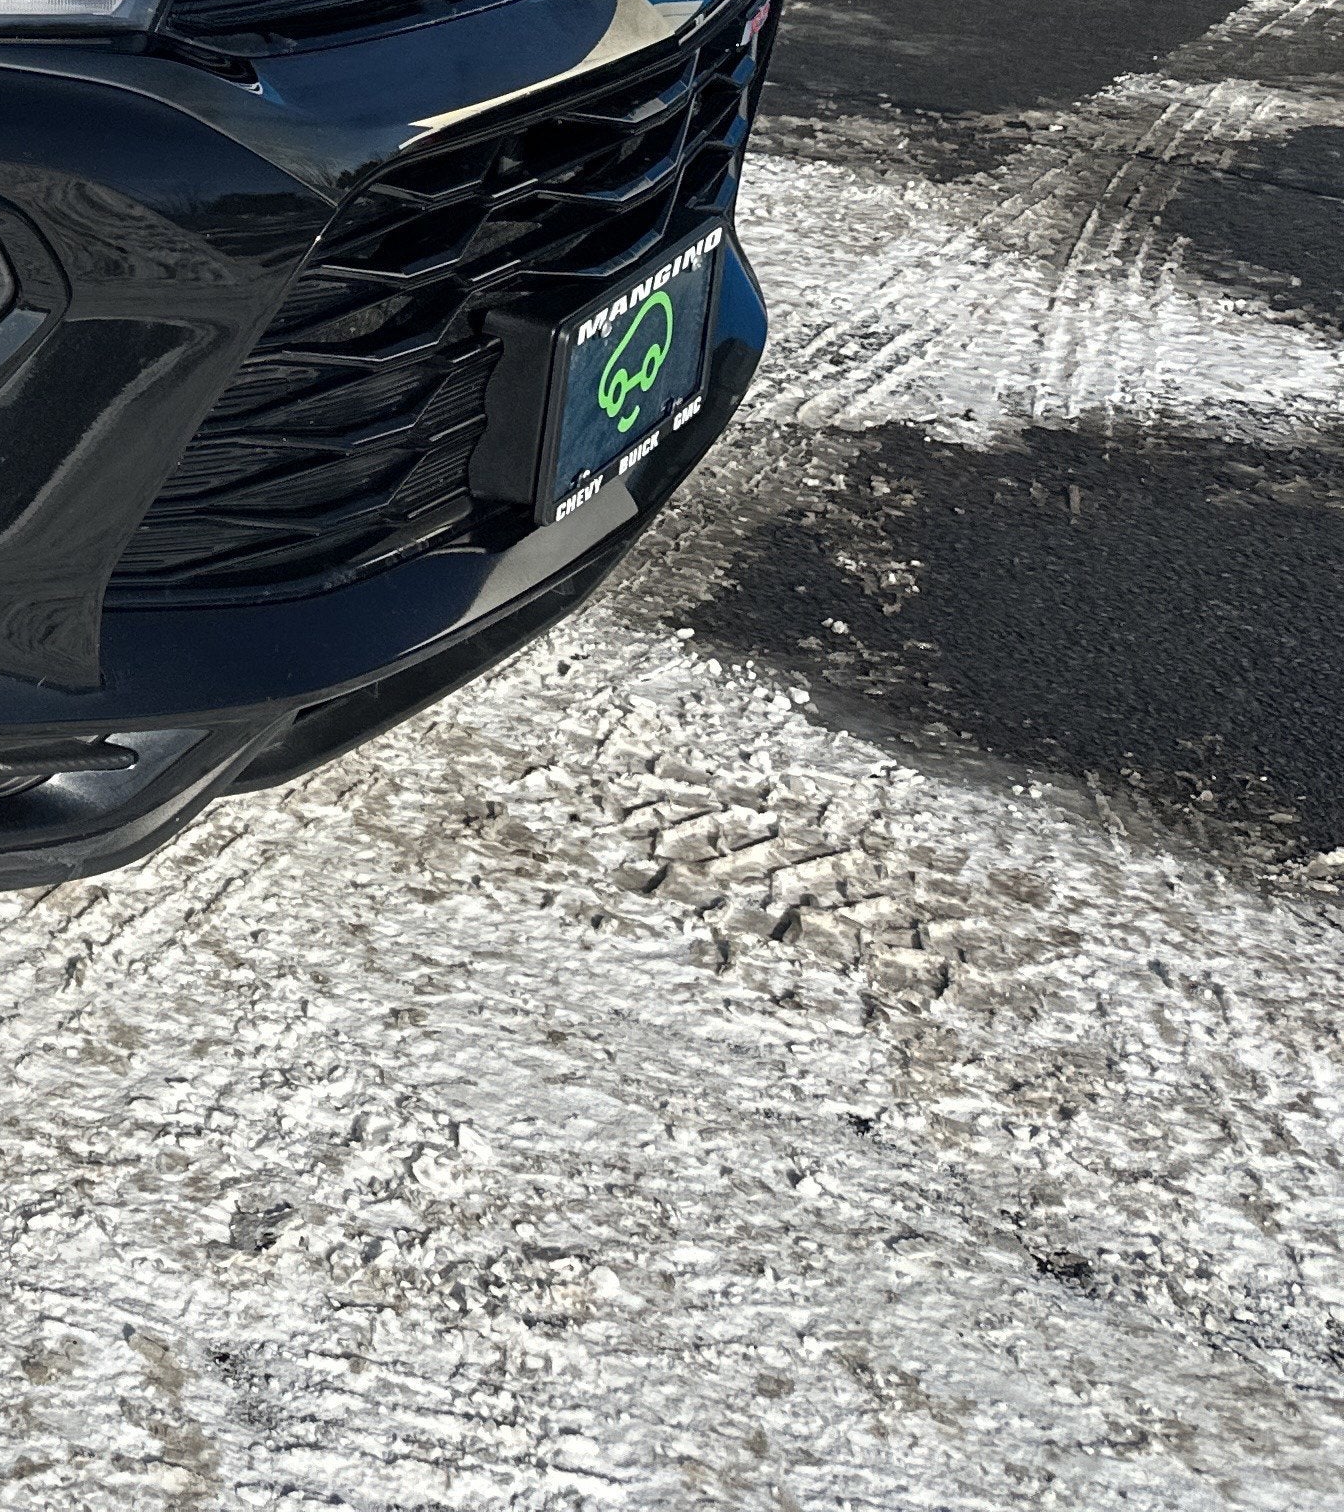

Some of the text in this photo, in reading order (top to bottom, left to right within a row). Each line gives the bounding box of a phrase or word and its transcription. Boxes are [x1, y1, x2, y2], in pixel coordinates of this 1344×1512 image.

[577, 227, 723, 346] MANGINO
[555, 395, 702, 522] CHEVY BUICK GMC
